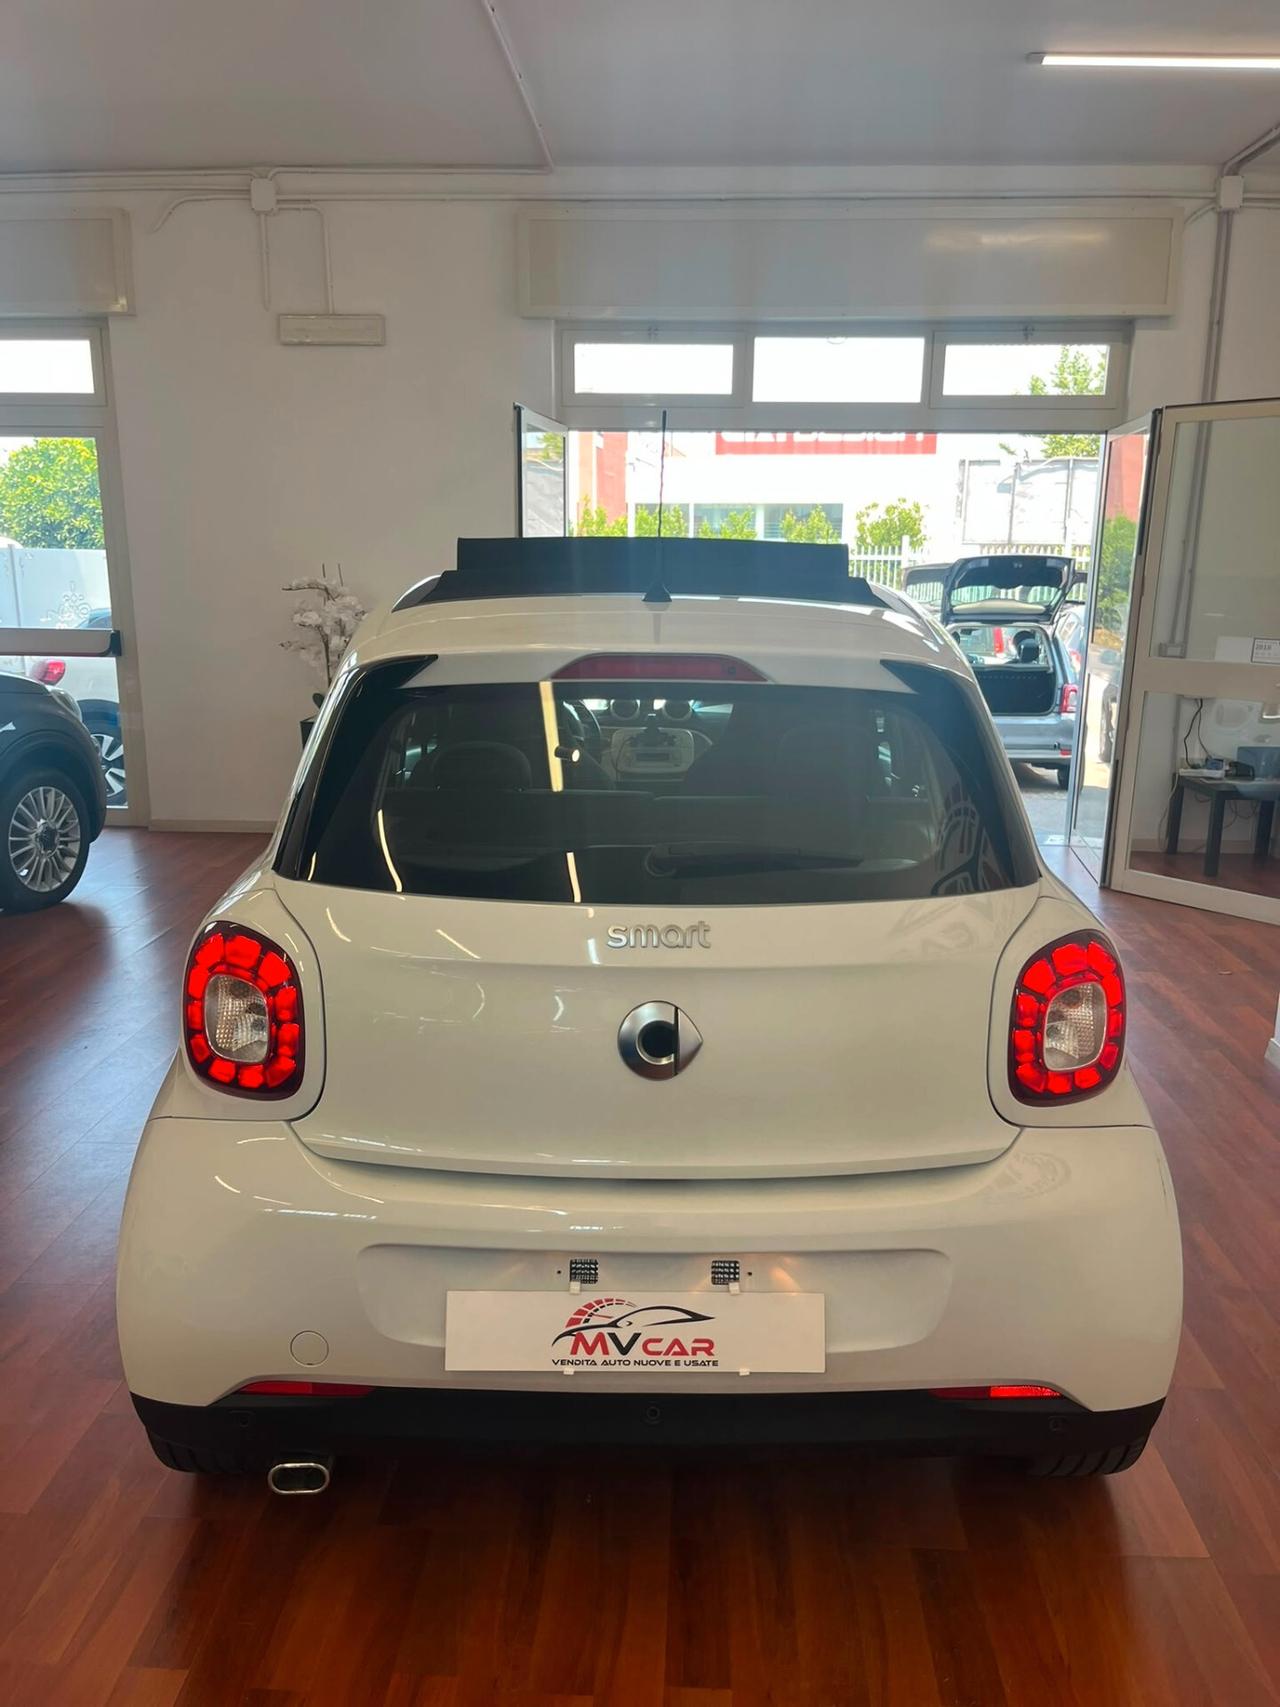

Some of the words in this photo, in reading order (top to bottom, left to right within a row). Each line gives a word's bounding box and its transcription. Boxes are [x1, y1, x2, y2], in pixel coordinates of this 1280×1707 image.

[607, 921, 712, 949] smart
[551, 1358, 597, 1366] VENDITA
[601, 1359, 631, 1367] AUTO
[633, 1359, 672, 1367] NUOVE
[674, 1359, 681, 1367] E
[683, 1359, 719, 1367] USATE
